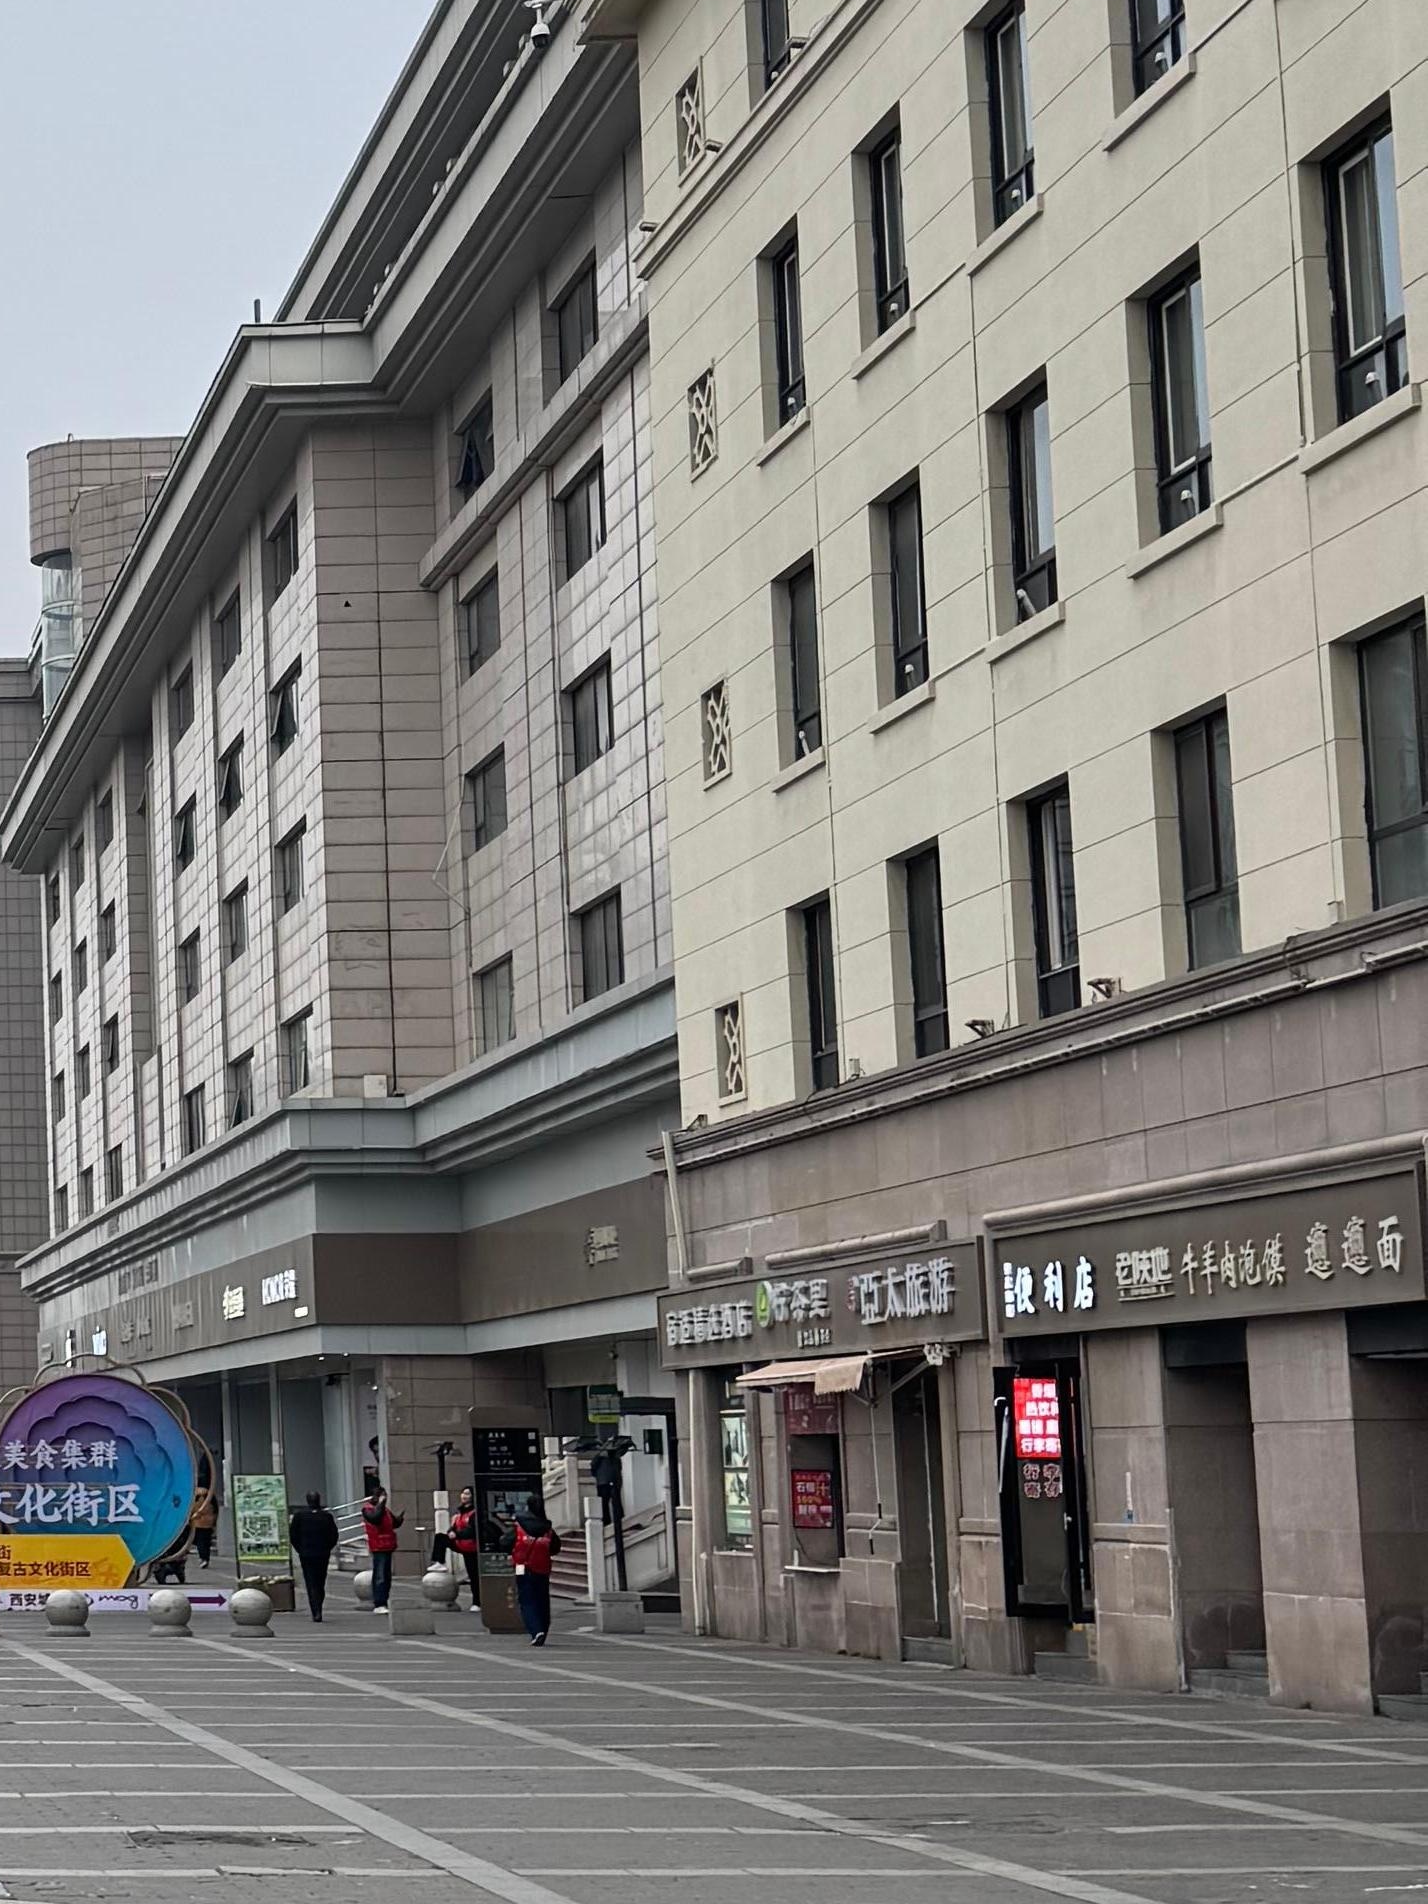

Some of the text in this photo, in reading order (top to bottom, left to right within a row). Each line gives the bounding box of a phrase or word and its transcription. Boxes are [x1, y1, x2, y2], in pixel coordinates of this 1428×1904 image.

[1014, 1256, 1095, 1314] 便利店
[1180, 1233, 1286, 1295] 牛羊肉泡馍
